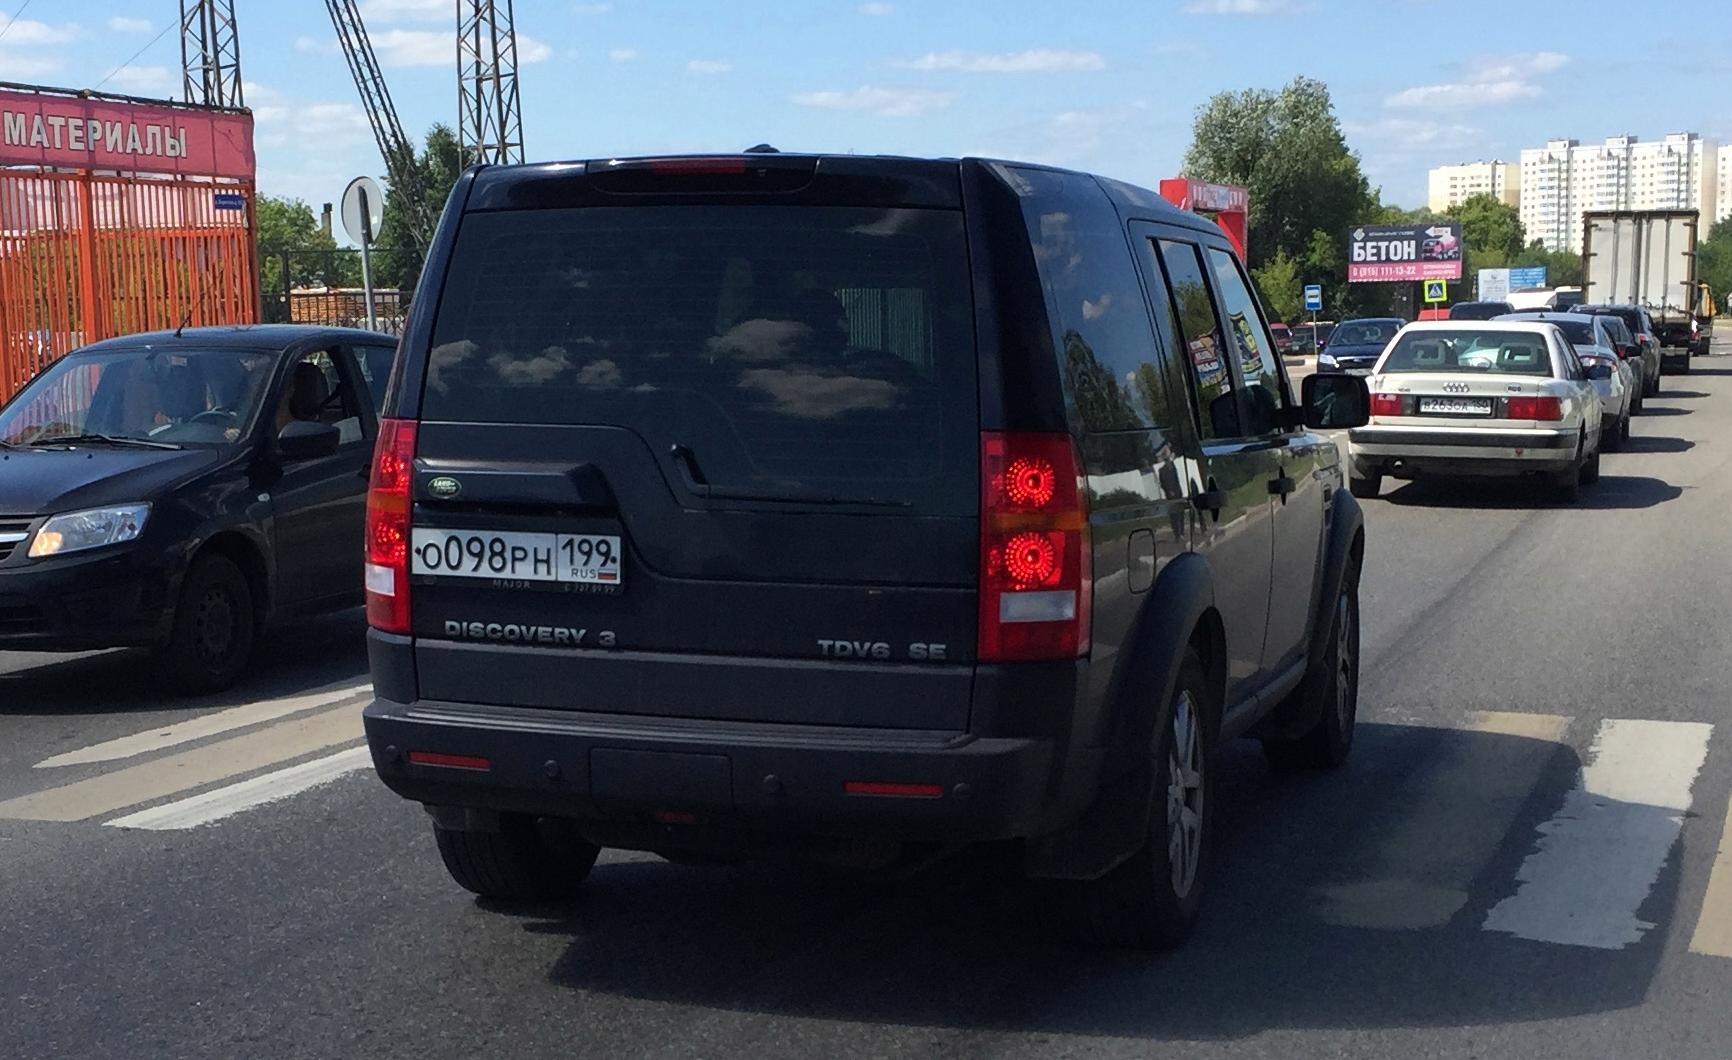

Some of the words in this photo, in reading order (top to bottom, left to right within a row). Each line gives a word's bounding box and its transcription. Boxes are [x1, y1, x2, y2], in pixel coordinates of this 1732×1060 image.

[2, 110, 188, 159] МАТЕРИАЛЫ
[1352, 240, 1416, 261] БЕТОН
[421, 535, 552, 576] О098РН
[561, 538, 613, 568] 199
[571, 568, 597, 580] RUS
[444, 620, 587, 645] DISCOVERY
[598, 631, 616, 647] 3
[816, 640, 891, 659] TDV6
[907, 642, 947, 660] SE
